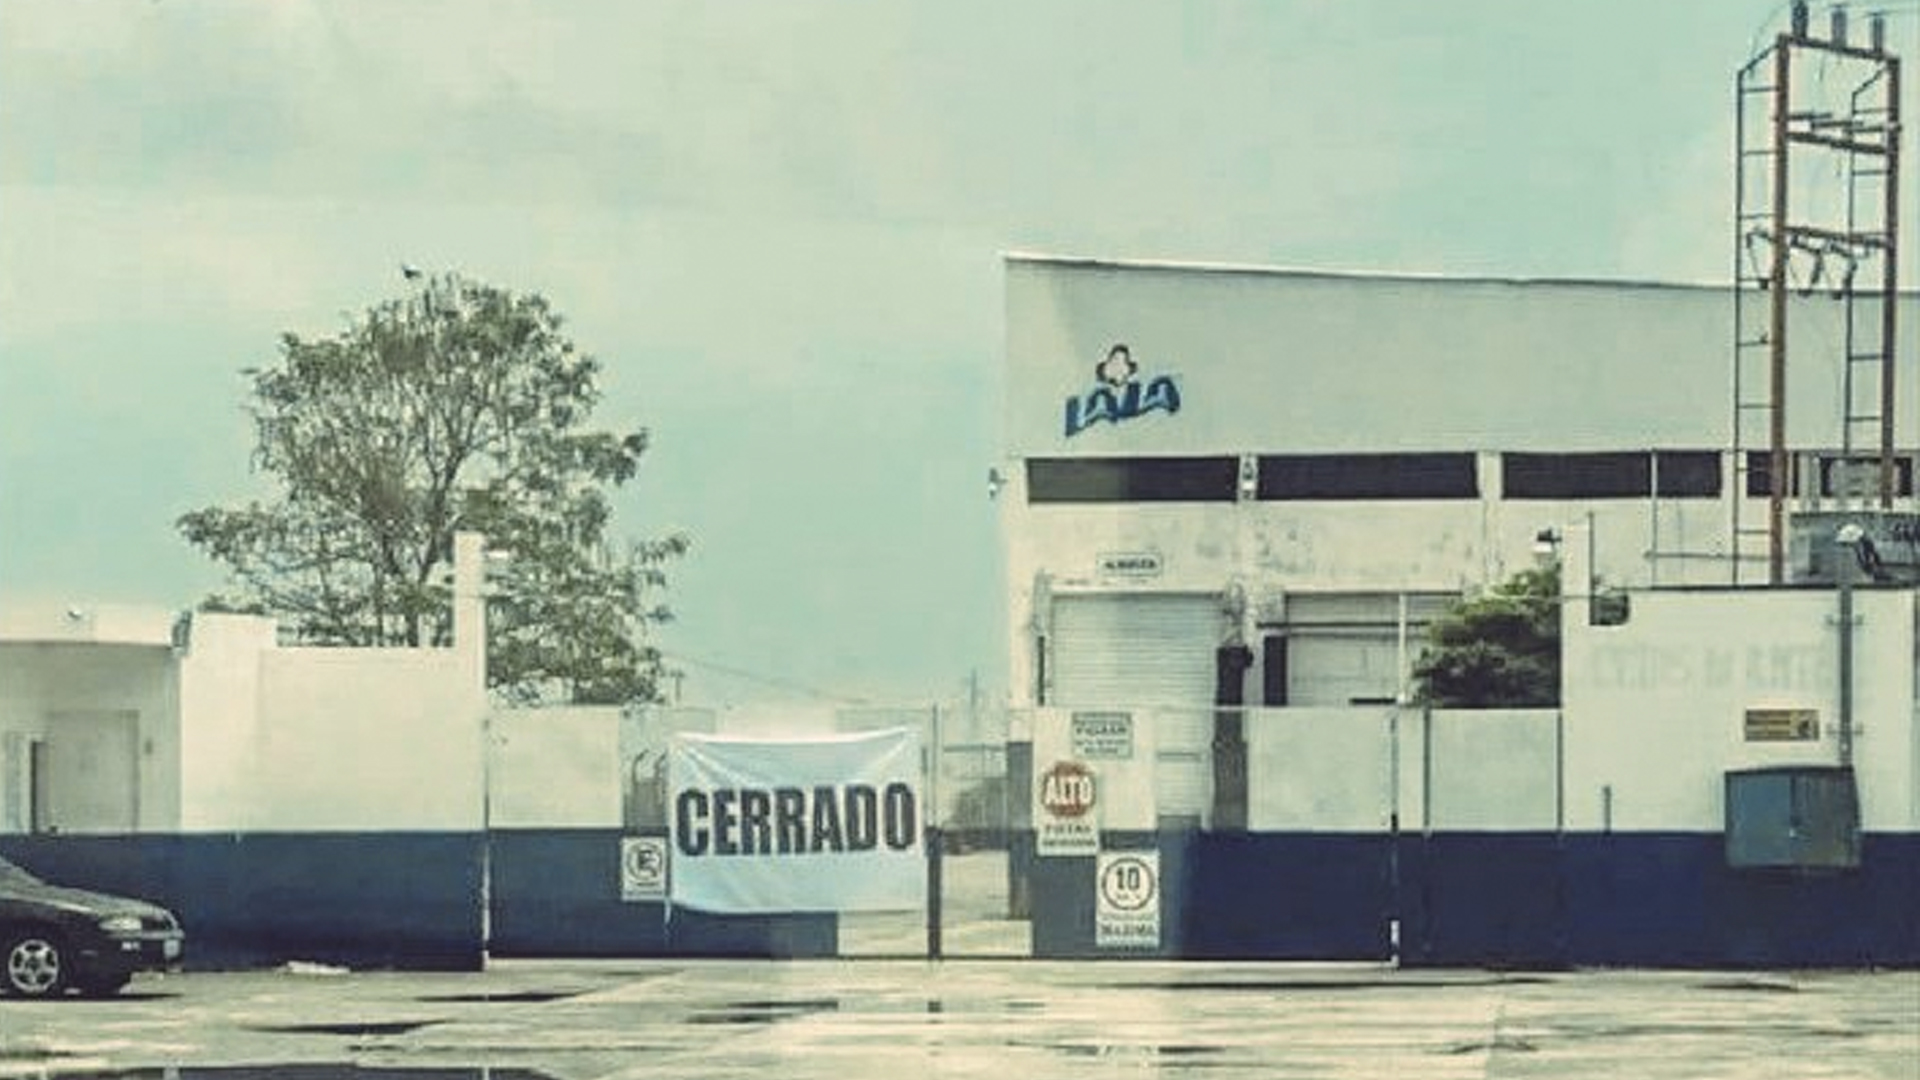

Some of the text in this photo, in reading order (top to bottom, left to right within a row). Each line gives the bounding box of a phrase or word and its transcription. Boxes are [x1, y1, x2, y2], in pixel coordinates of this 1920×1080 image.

[1044, 776, 1093, 805] ALTO
[676, 782, 916, 857] CERRADO
[1116, 866, 1140, 890] 10
